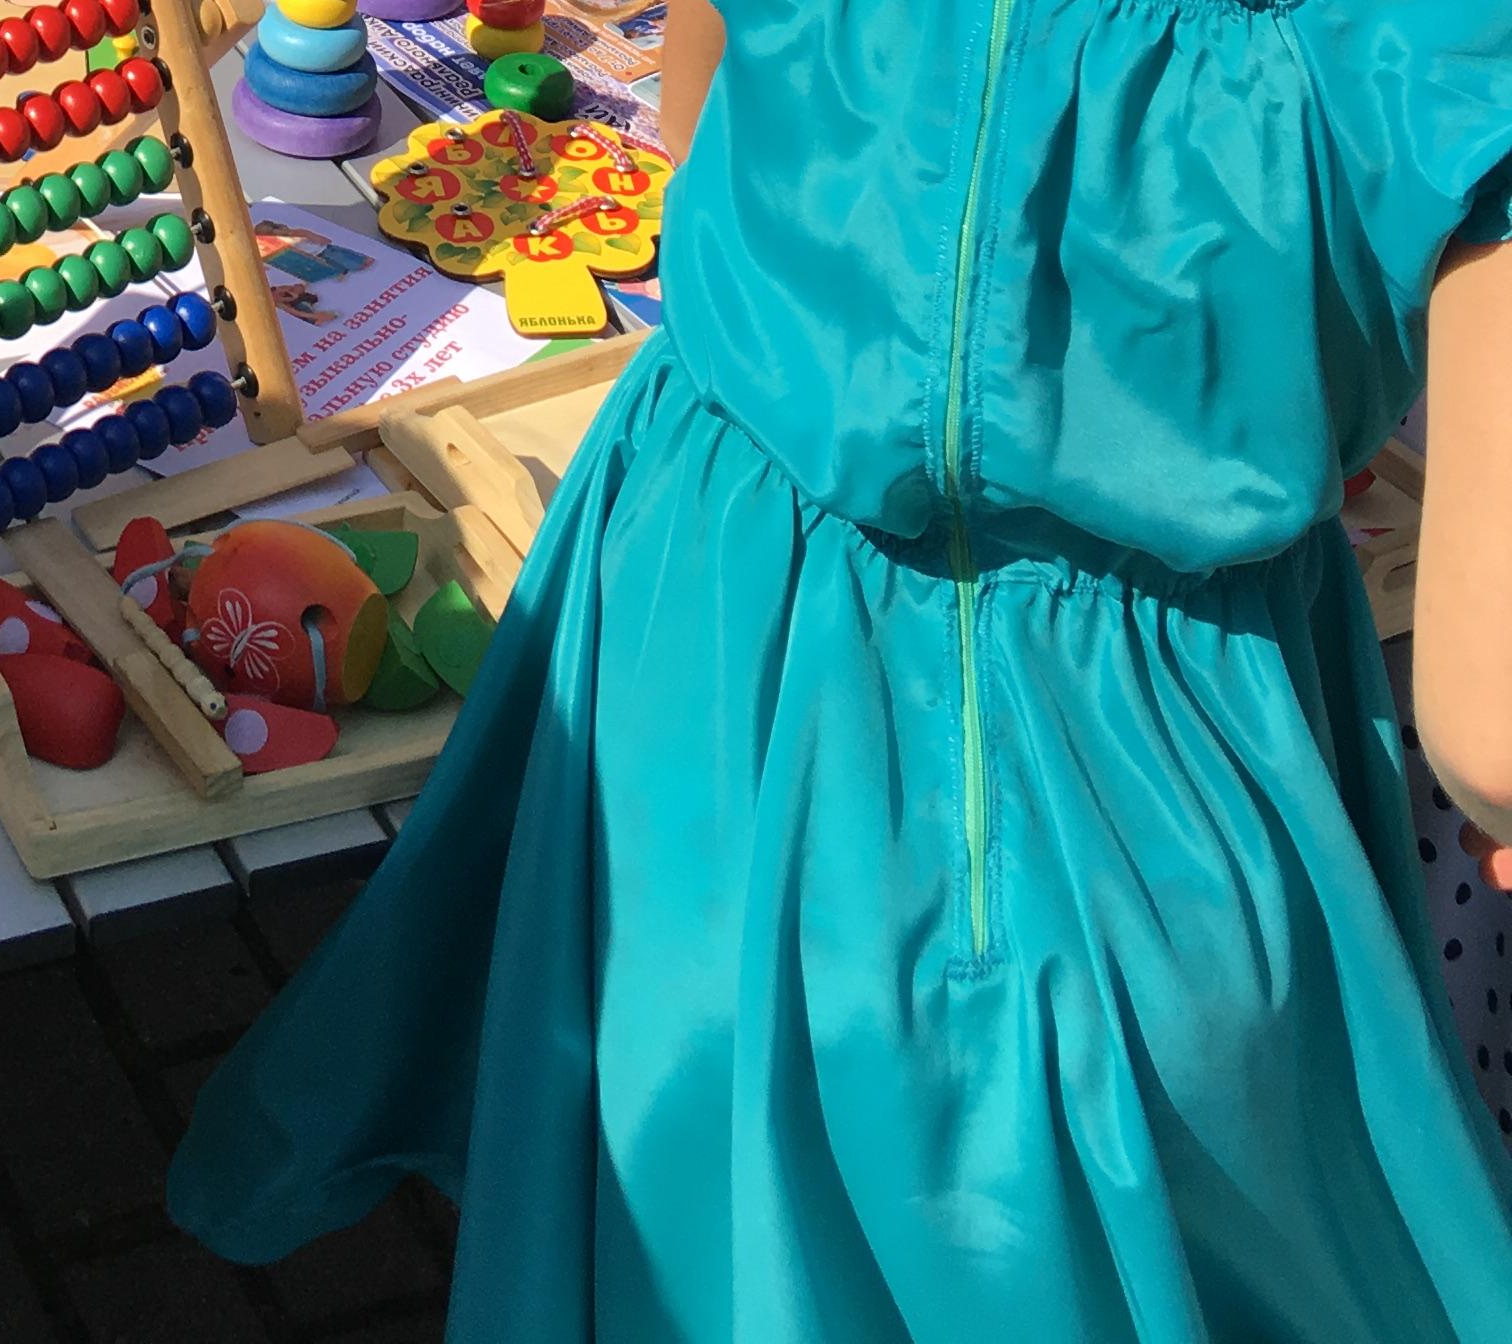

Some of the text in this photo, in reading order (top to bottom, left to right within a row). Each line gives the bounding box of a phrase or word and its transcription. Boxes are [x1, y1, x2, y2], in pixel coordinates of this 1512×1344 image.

[368, 40, 480, 119] ининградский
[413, 176, 446, 198] Я
[452, 218, 478, 239] А
[312, 329, 347, 353] на
[343, 266, 434, 330] занятия
[519, 315, 596, 328] ЯБЛОНЬКА
[300, 314, 408, 404] зыкально-
[307, 303, 470, 423] альную студию
[424, 340, 463, 373] лет
